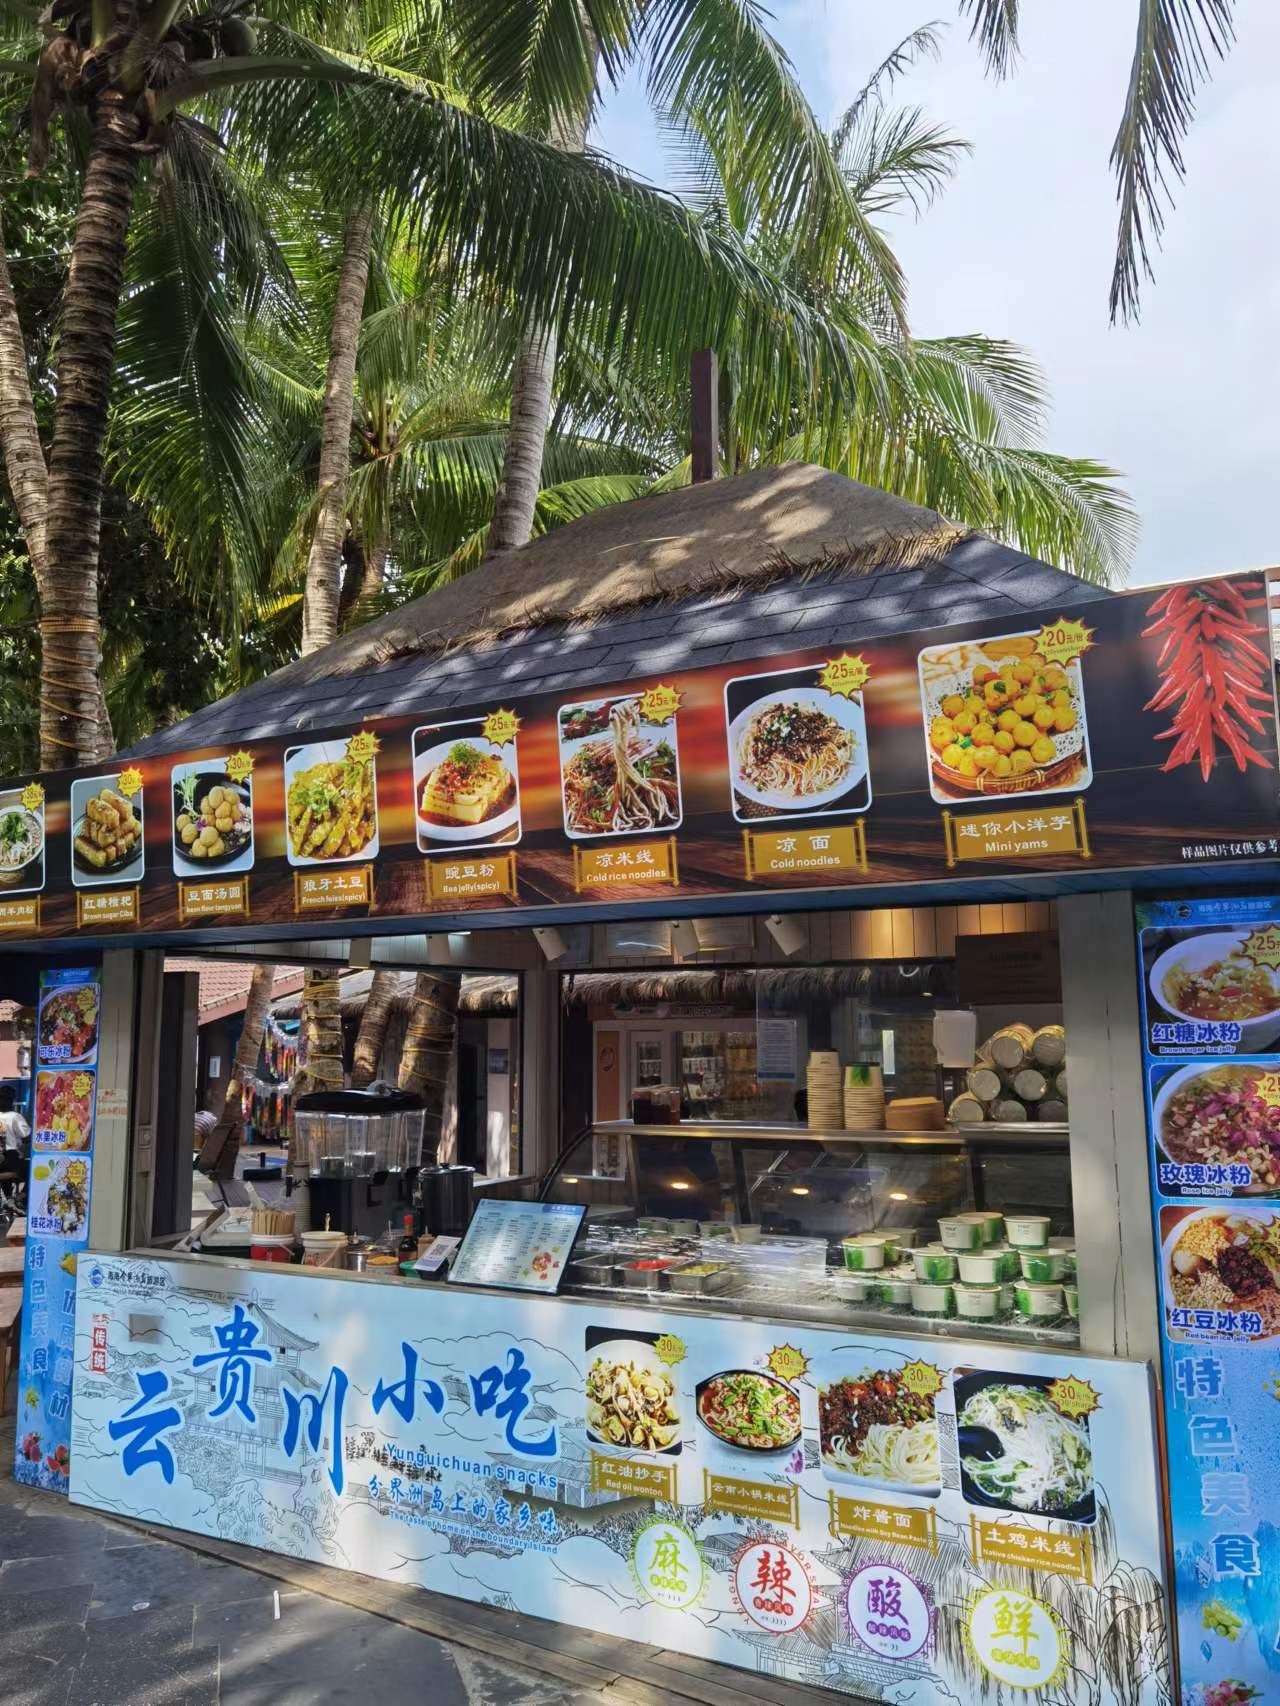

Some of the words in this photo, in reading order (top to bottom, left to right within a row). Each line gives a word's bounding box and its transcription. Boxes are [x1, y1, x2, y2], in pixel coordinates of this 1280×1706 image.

[960, 816, 1071, 837] 迷你小洋芋
[776, 835, 831, 853] 凉面
[985, 841, 1012, 853] Mini
[1014, 840, 1049, 853] yams
[1181, 840, 1279, 859] 样品图片仅供参考
[595, 849, 656, 867] 凉米线
[770, 858, 796, 869] Cold
[797, 855, 841, 868] noodles
[445, 864, 496, 880] 豌豆粉
[586, 873, 608, 882] Cold
[608, 871, 628, 881] rice
[628, 868, 667, 880] noodles
[304, 876, 364, 892] 狼牙土豆
[1152, 1022, 1241, 1043] 红糖冰粉
[1160, 1163, 1251, 1185] 玫瑰冰粉
[31, 1216, 61, 1229] 桂花冰粉
[29, 1245, 49, 1372] 特色美食
[1171, 1308, 1262, 1333] 红豆冰粉
[108, 1304, 562, 1496] 云贵川小吃
[386, 1443, 491, 1477] Yunguichuan
[496, 1466, 557, 1489] snacks
[600, 1462, 668, 1483] 红油抄手
[1176, 1357, 1260, 1575] 特色美食
[606, 1479, 621, 1489] Red
[622, 1482, 632, 1490] oil
[633, 1485, 663, 1497] wonton
[368, 1474, 557, 1533] 分界洲岛上的家乡味
[406, 1515, 426, 1526] taste
[437, 1521, 459, 1533] home
[461, 1527, 471, 1535] on
[473, 1529, 487, 1539] the
[488, 1532, 528, 1549] boundary
[985, 1527, 1076, 1558] 土鸡米线
[648, 1530, 689, 1578] 麻
[750, 1549, 797, 1601] 辣
[1051, 1560, 1081, 1572] noodles
[867, 1575, 909, 1626] 酸
[990, 1595, 1040, 1657] 鲜
